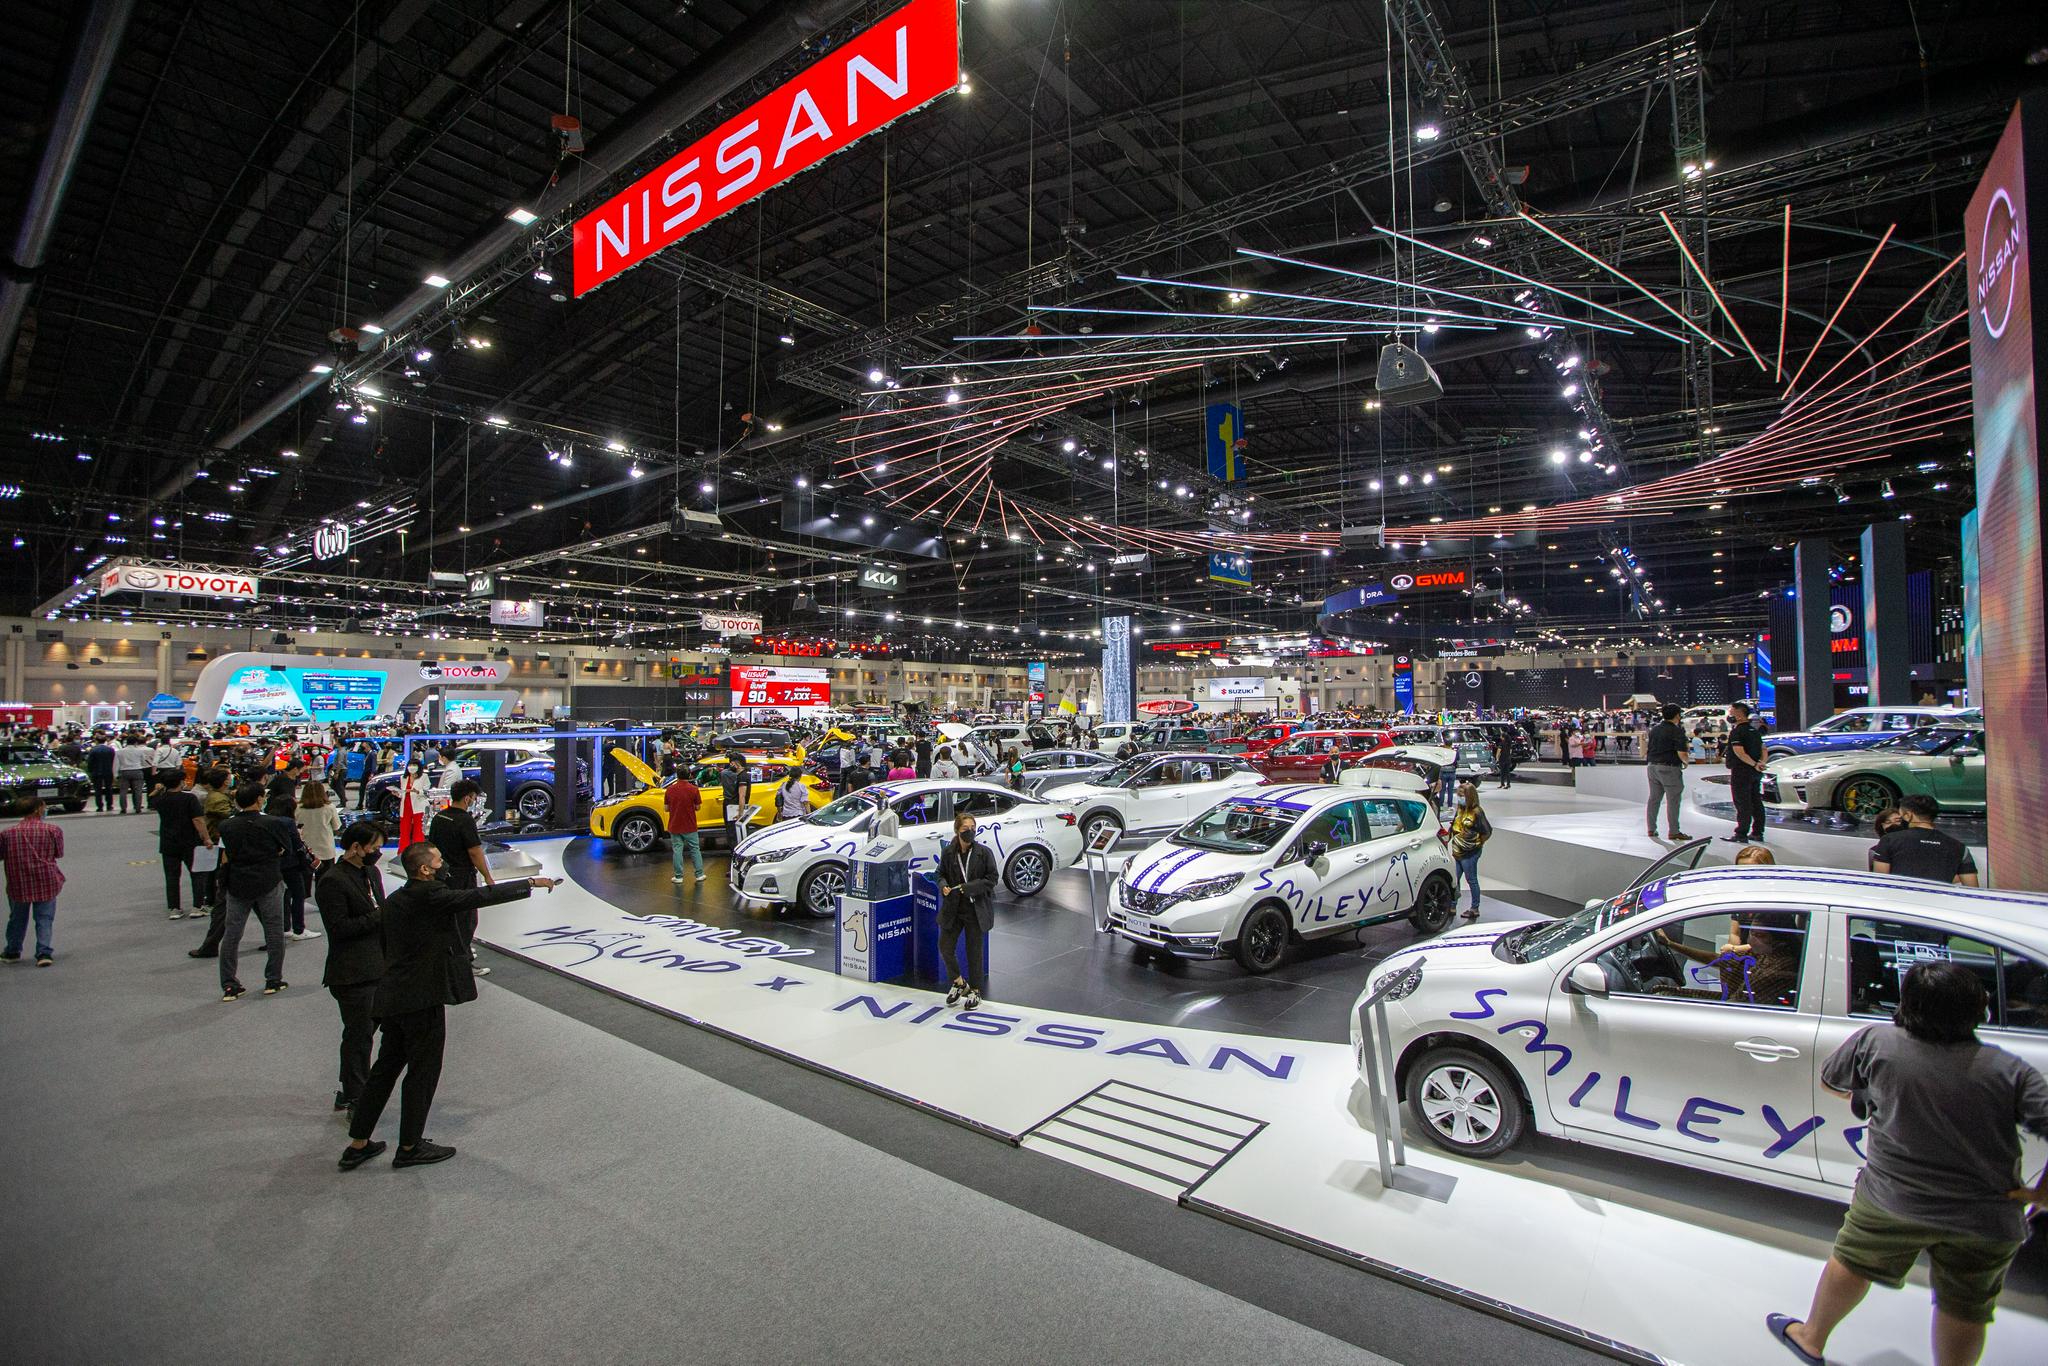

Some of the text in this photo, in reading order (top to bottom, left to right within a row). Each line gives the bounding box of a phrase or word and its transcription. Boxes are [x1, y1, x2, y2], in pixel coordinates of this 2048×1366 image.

[596, 25, 909, 272] NISSAN
[1978, 220, 2019, 305] NISSAN
[163, 573, 255, 595] TOYOTA
[471, 577, 490, 592] KIA
[864, 570, 898, 585] KIA
[1415, 572, 1465, 587] GWM
[1366, 590, 1384, 599] ORA
[11, 625, 23, 634] 16
[720, 618, 761, 633] TOYOTA
[160, 631, 172, 640] 15
[774, 643, 821, 658] ISUZU
[1831, 637, 1859, 653] WM
[1438, 649, 1479, 658] Mercedes-Benz
[443, 667, 498, 682] TOYOTA
[747, 690, 767, 704] 90
[1228, 688, 1255, 696] SUZUKI
[1253, 868, 1375, 923] SMILEY
[916, 897, 938, 911] NISSAN
[1127, 917, 1147, 927] NOTE
[622, 914, 816, 958] SMILEY
[877, 925, 913, 942] NISSAN
[843, 962, 868, 972] NISSAN
[833, 995, 1296, 1081] NISSAN
[1450, 988, 1826, 1158] SMILEY
